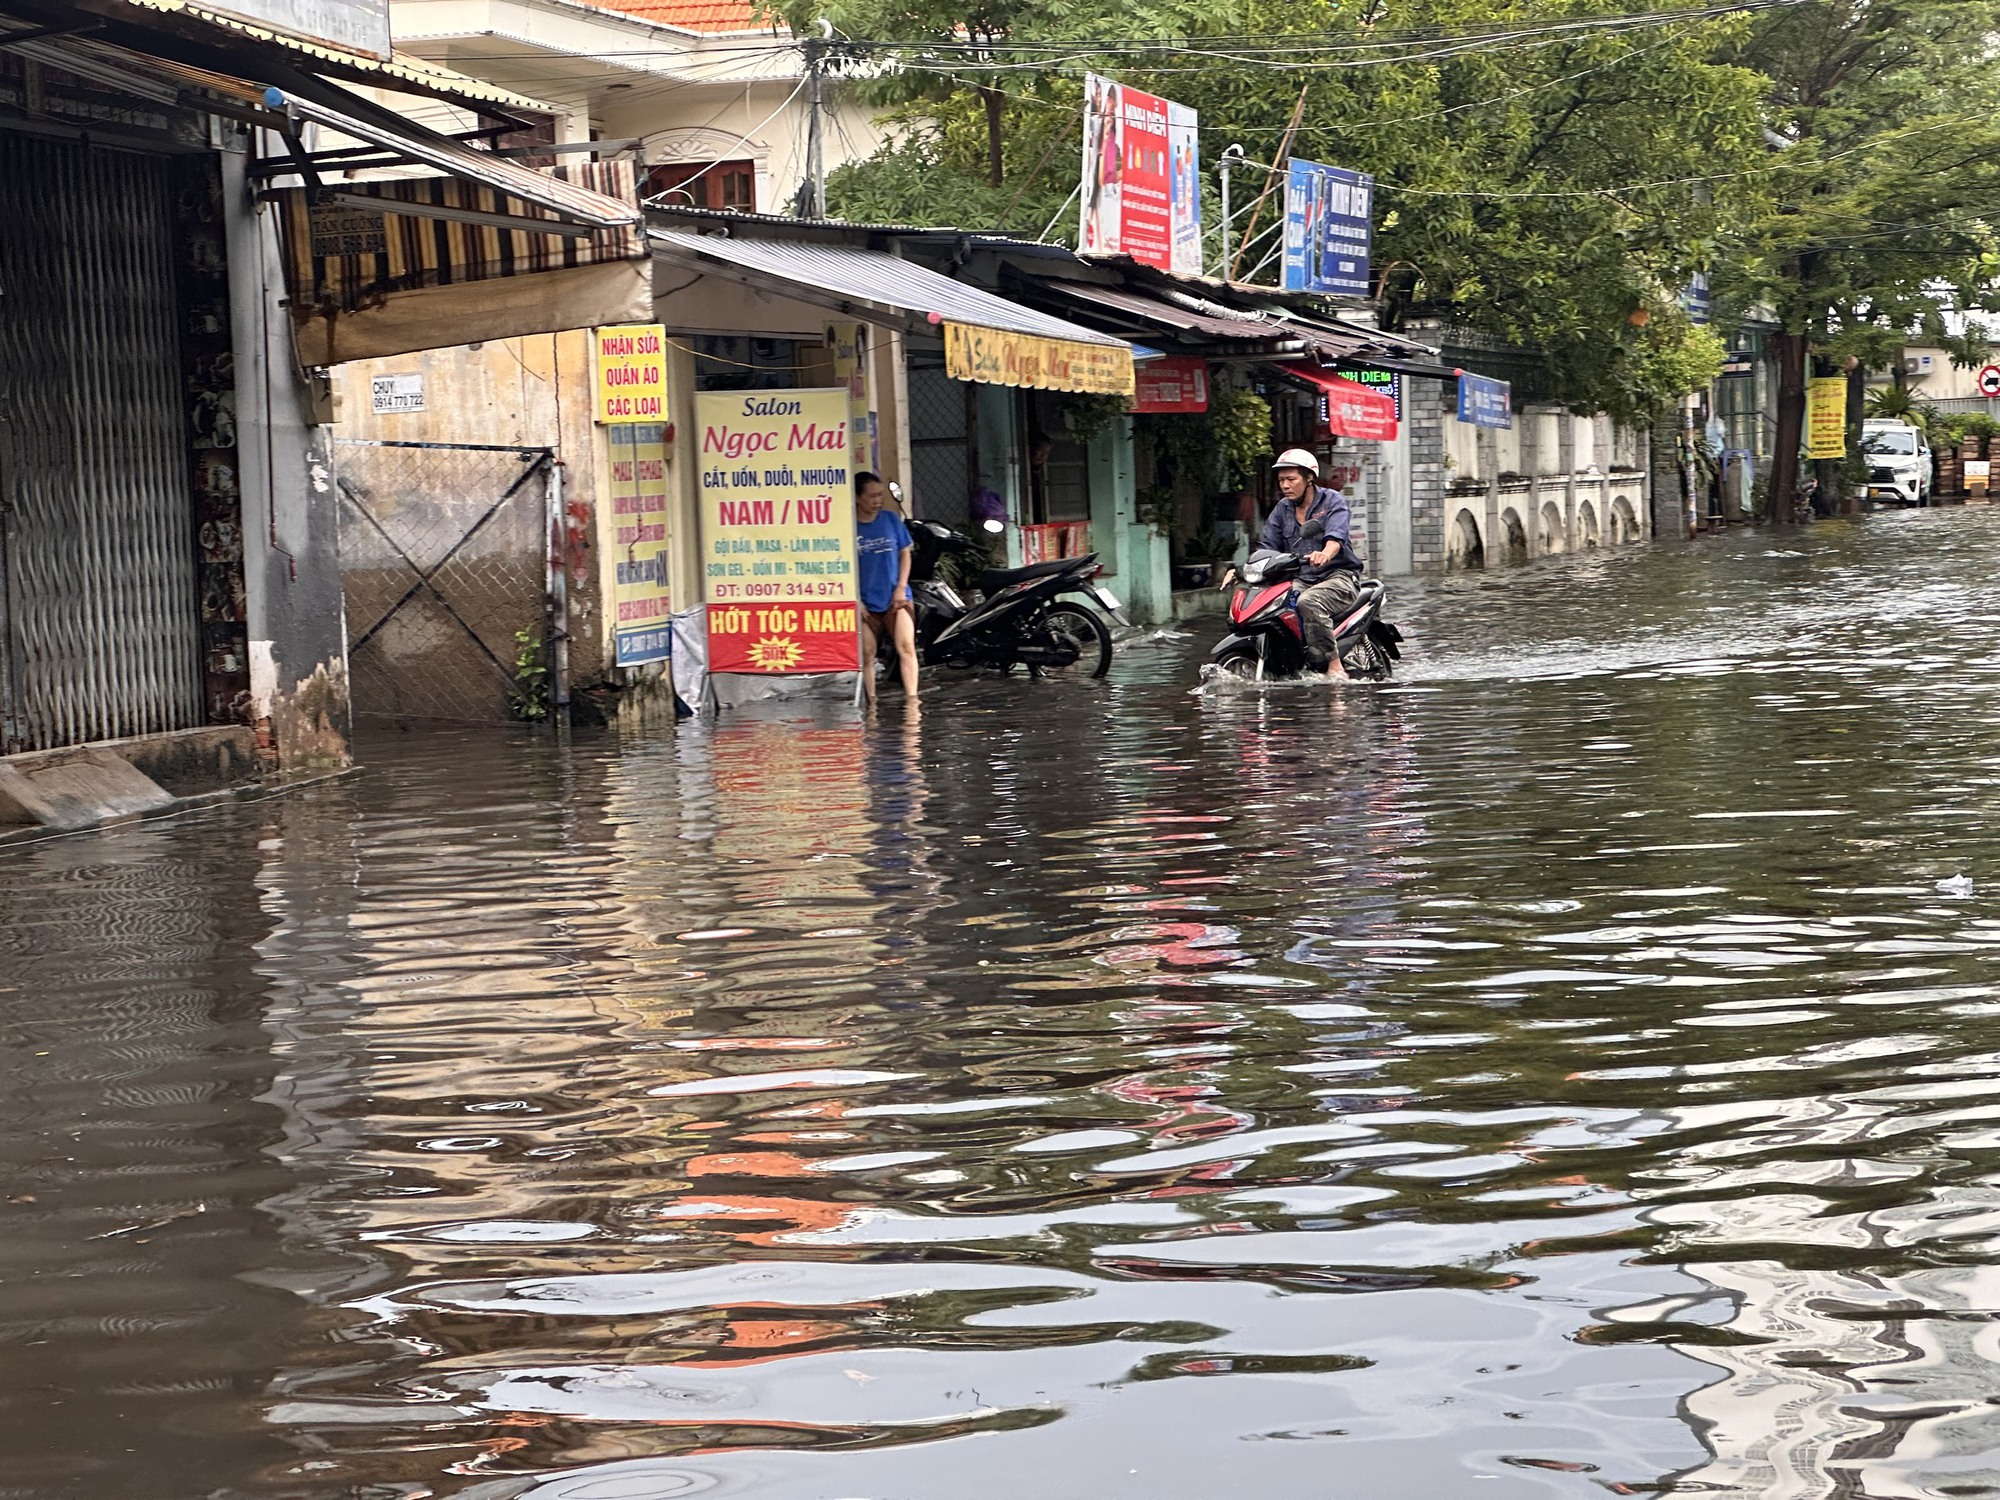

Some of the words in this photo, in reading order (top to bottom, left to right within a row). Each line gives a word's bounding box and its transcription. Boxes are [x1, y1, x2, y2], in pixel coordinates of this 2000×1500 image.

[602, 334, 634, 359] NHẬN
[637, 331, 660, 354] SỬA
[643, 363, 659, 384] ÁO
[374, 398, 392, 407] 0914
[394, 395, 407, 406] 770
[409, 395, 424, 405] 722
[607, 394, 631, 416] CÁC
[634, 397, 661, 418] LOẠI
[742, 398, 801, 416] Salon
[703, 425, 778, 458] Ngọc
[788, 422, 846, 450] Mai
[703, 466, 728, 489] CẮT,
[732, 465, 761, 488] UỐN,
[765, 464, 797, 487] DUỖI,
[801, 466, 846, 488] NHUỘM
[720, 500, 774, 525] NAM
[781, 500, 790, 525] /
[797, 495, 833, 524] NỮ
[756, 540, 782, 553] MASA
[728, 563, 744, 576] GEL
[795, 561, 825, 575] TRANG
[716, 584, 740, 597] ĐT:
[746, 584, 781, 596] 0907
[787, 583, 813, 596] 314
[818, 583, 844, 595] 971
[710, 606, 751, 634] HỚT
[756, 605, 798, 633] TÓC
[804, 609, 856, 633] NAM
